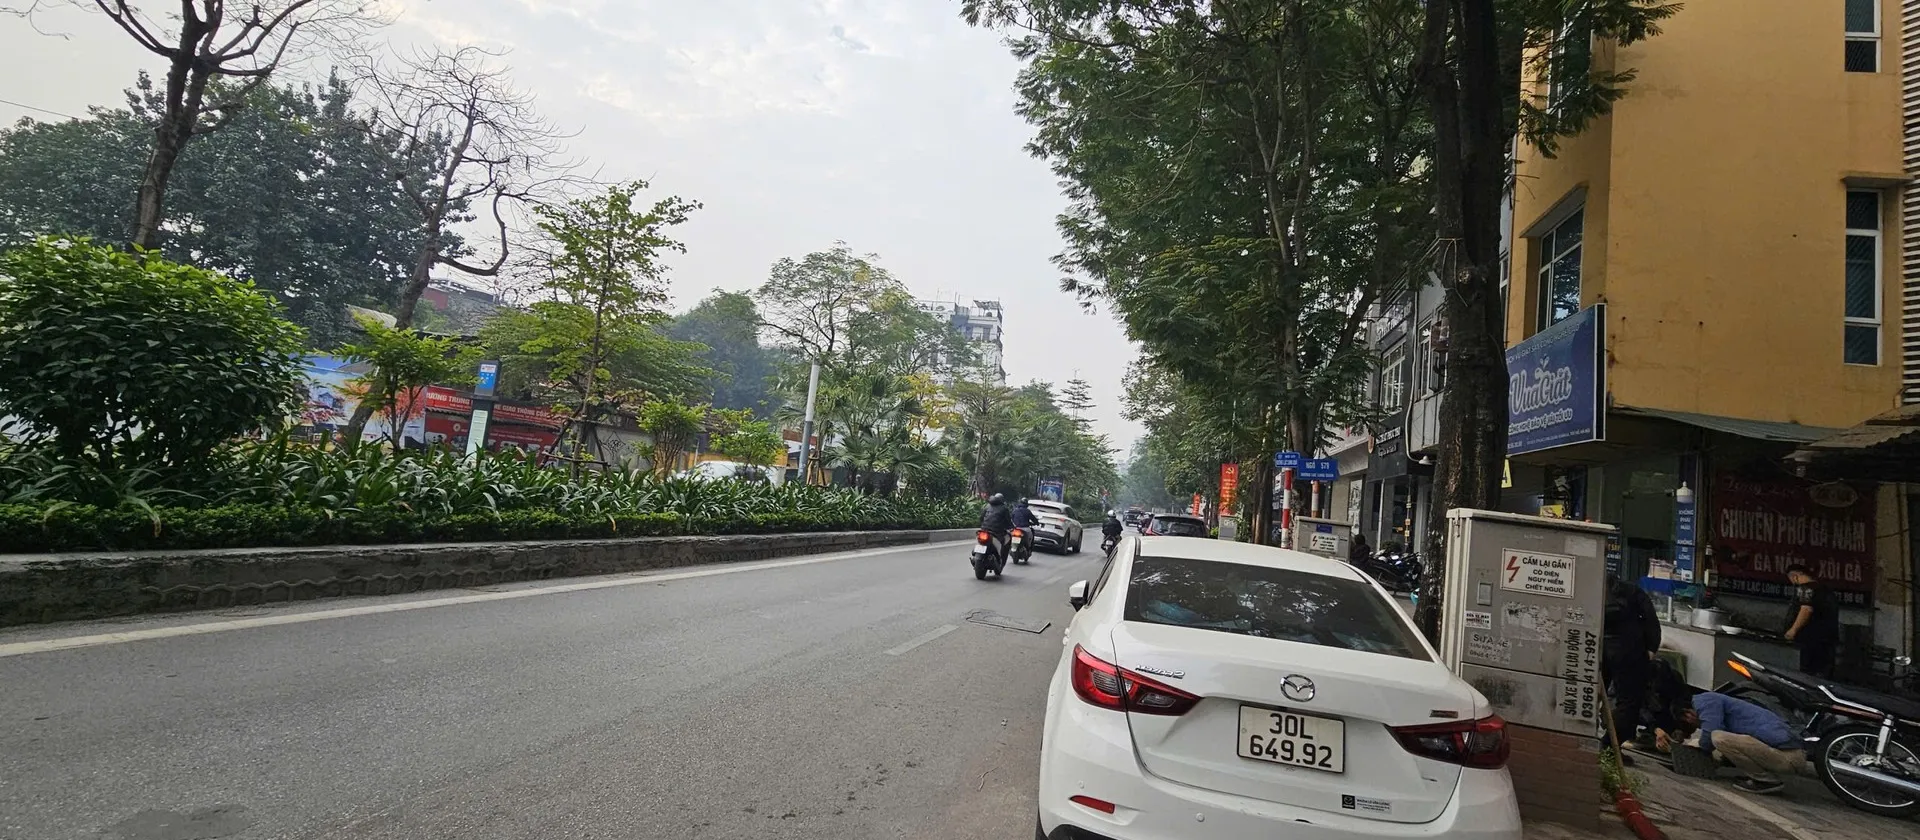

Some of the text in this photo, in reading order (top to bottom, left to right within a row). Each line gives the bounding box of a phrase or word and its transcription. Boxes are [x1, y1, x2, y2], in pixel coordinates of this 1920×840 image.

[1720, 502, 1773, 542] CHUYÊN
[1777, 507, 1808, 546] PHỞ
[1522, 555, 1538, 566] CẤM
[1539, 559, 1550, 569] LẠI
[1564, 629, 1582, 651] ĐỘNG
[1566, 652, 1579, 668] LƯU
[1581, 631, 1597, 719] 0366.414.997
[1564, 686, 1577, 698] XE
[1269, 713, 1314, 740] 30L
[1250, 734, 1332, 768] 649.92
